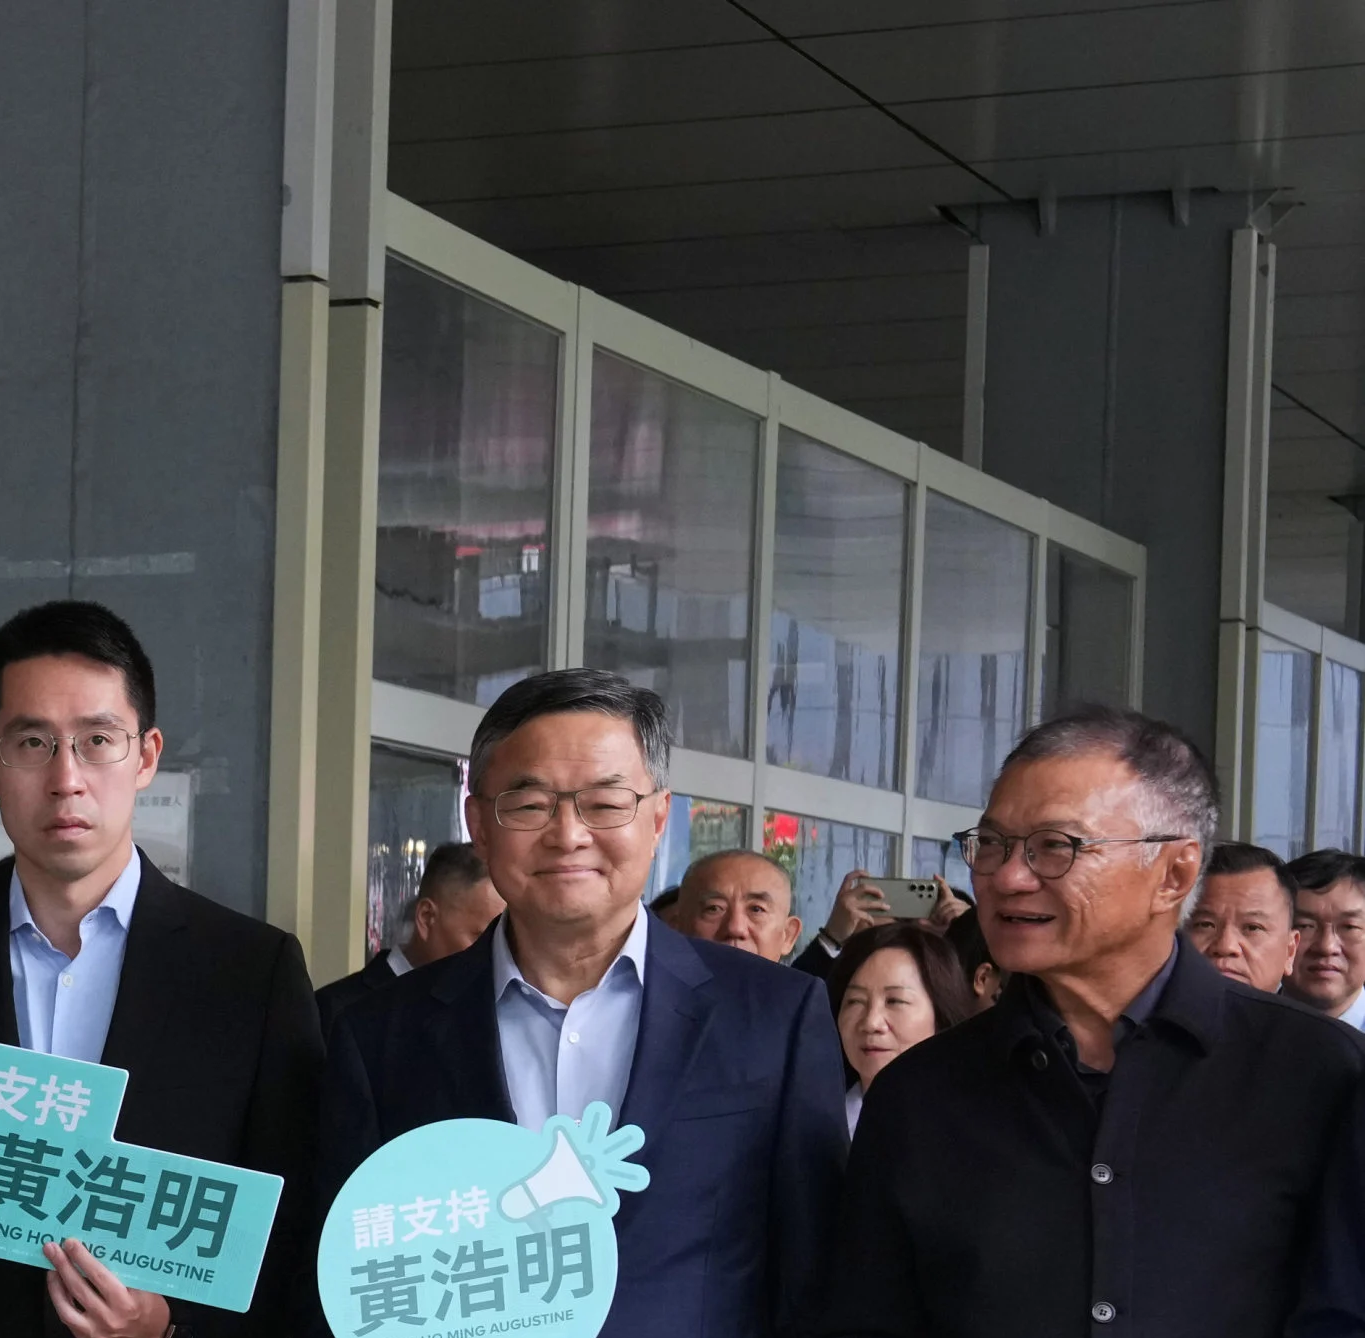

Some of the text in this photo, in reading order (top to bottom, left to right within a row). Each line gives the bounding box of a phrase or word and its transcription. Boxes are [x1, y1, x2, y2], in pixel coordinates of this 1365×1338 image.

[352, 1186, 490, 1250] 請支持
[27, 1229, 55, 1246] HO
[110, 1249, 216, 1284] AUGUSTINE
[349, 1222, 594, 1338] 黃浩明
[489, 1309, 574, 1334] AUGUSTINE
